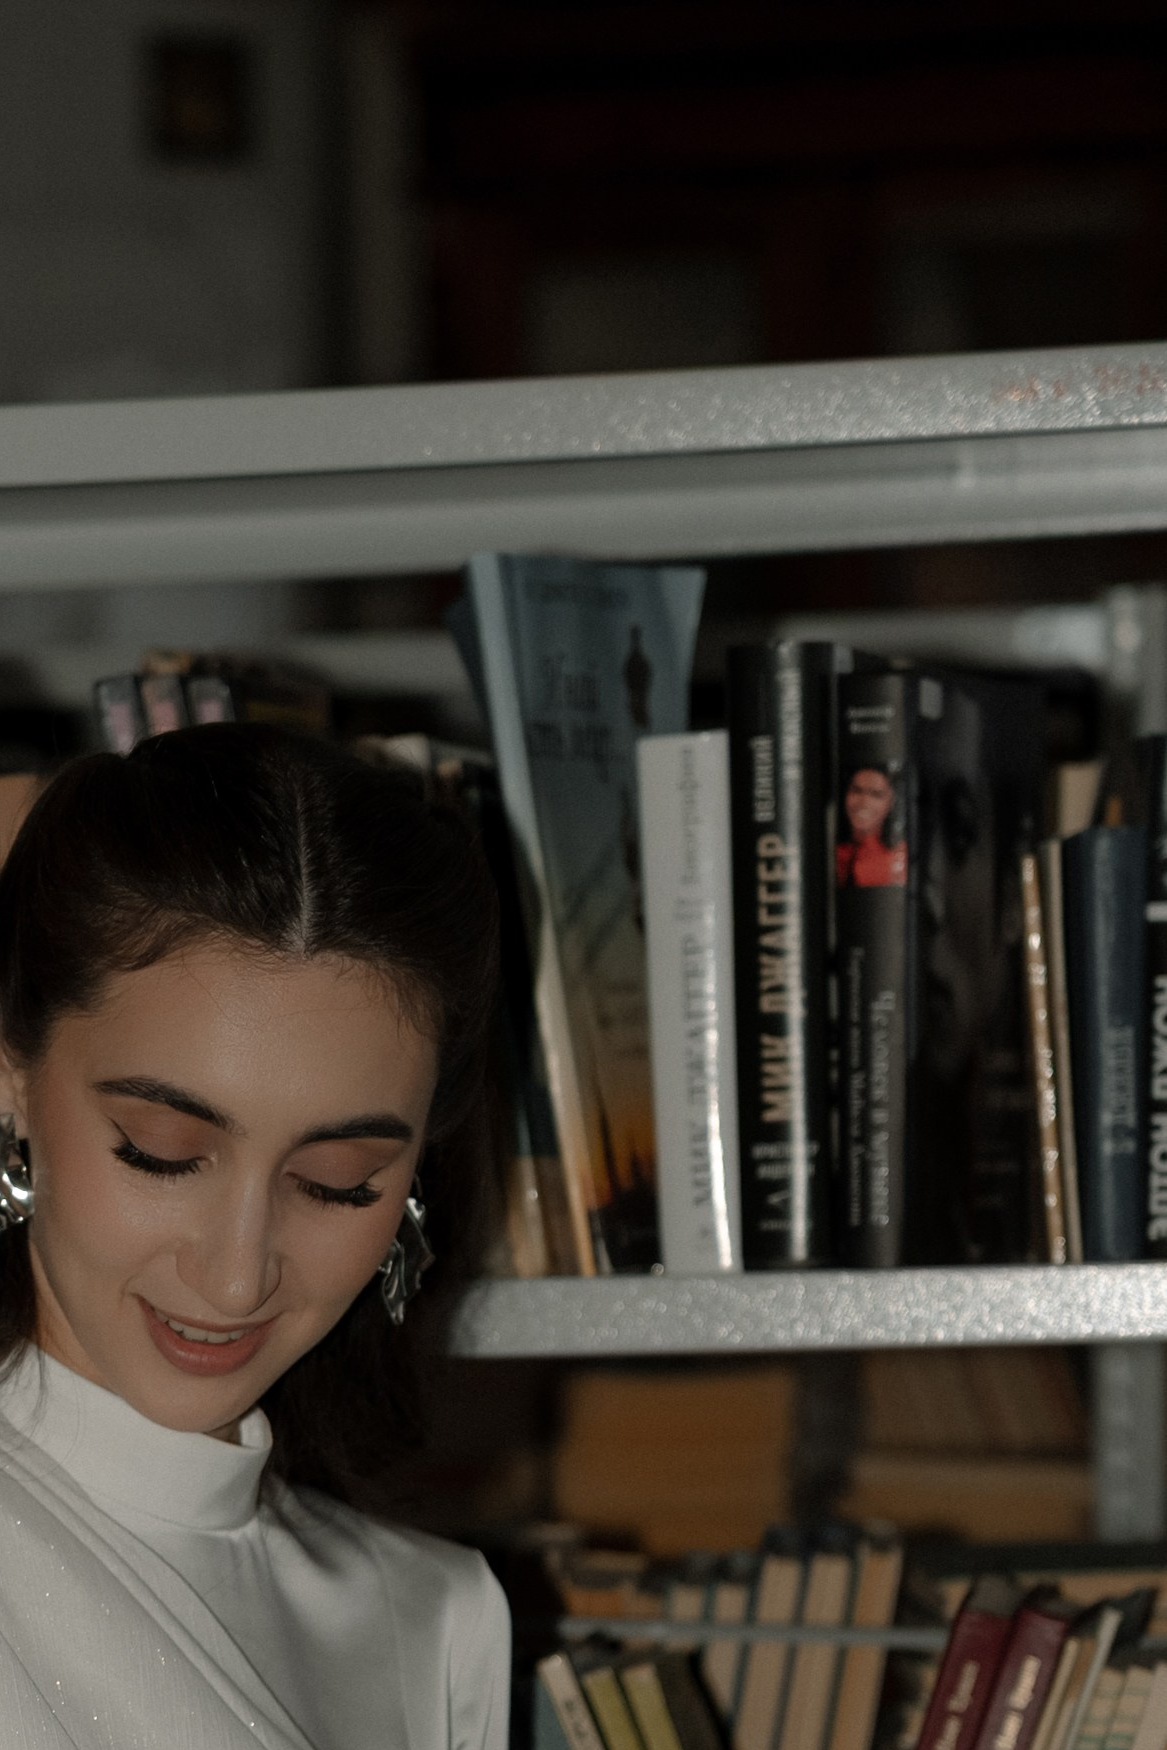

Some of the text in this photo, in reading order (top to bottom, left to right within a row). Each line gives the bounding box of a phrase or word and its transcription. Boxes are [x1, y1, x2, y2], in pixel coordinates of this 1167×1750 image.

[750, 735, 776, 822] ВЕЛИКИЙ
[756, 833, 806, 1017] ДЖАГГЕР
[760, 1033, 802, 1124] МИК
